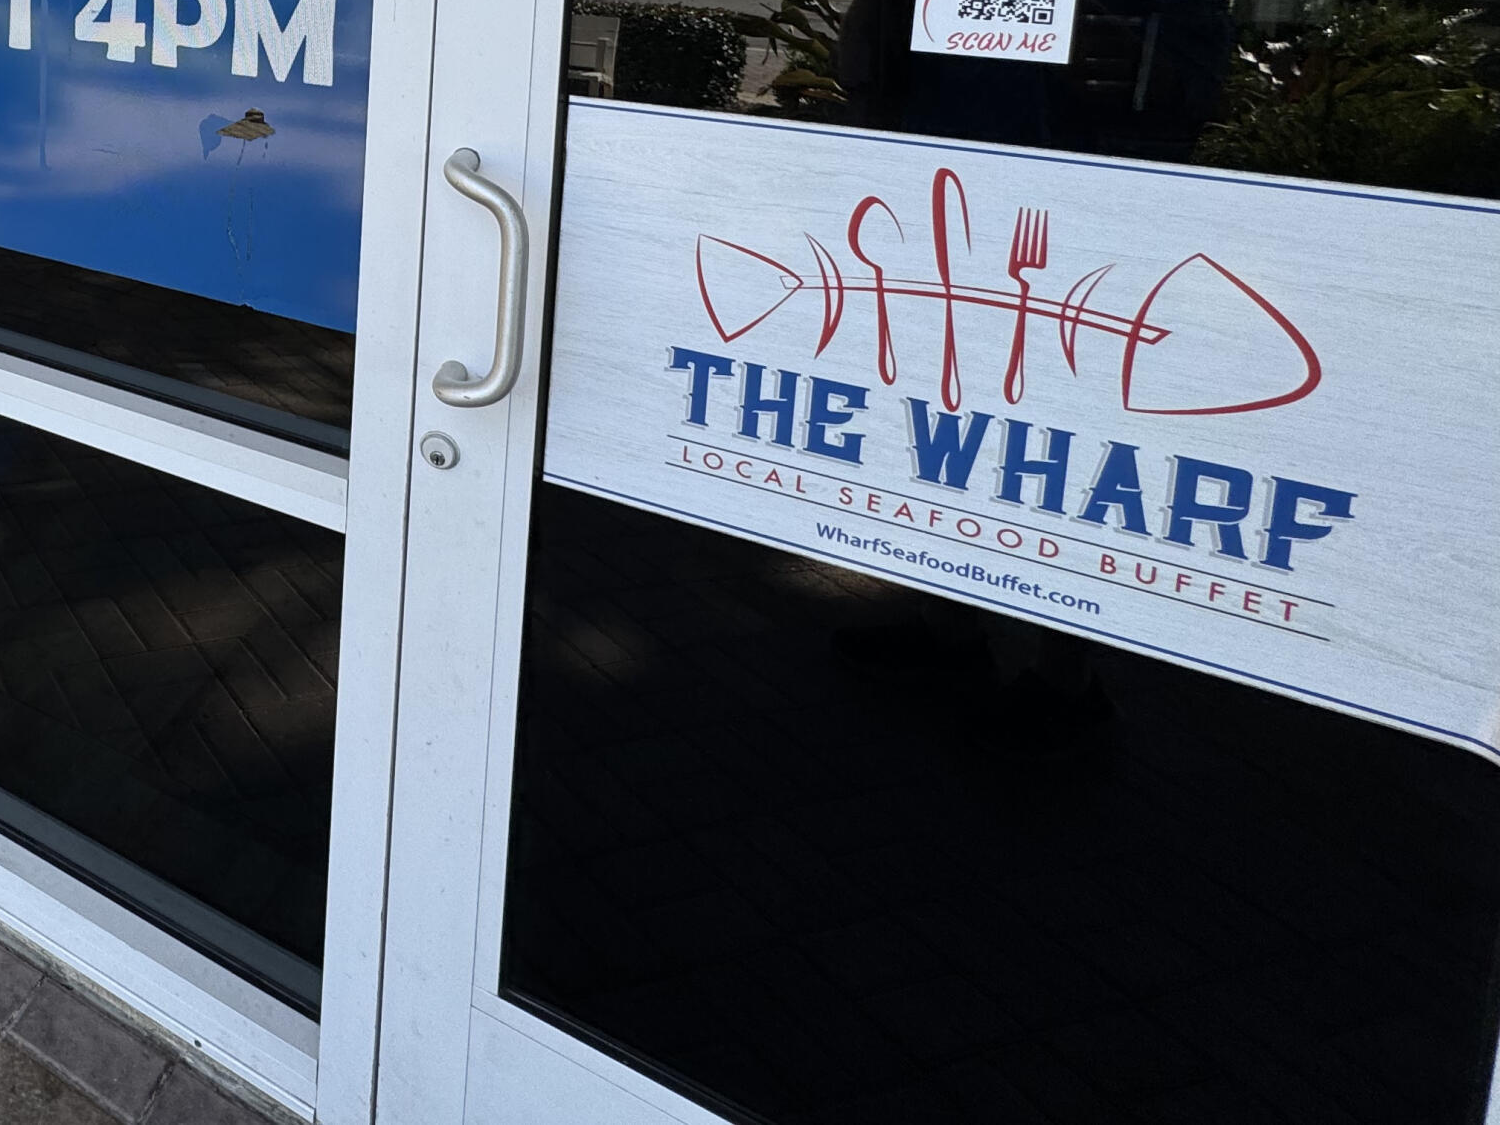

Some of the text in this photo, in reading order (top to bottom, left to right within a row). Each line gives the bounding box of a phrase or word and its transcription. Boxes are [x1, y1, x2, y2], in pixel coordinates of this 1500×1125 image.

[946, 31, 1056, 53] SCAN ME
[665, 345, 1358, 572] THE WHARF
[682, 445, 1299, 623] LOCAL SEAFOOD BUFFET
[816, 521, 1101, 616] WharfSeafoodBuffet.com
